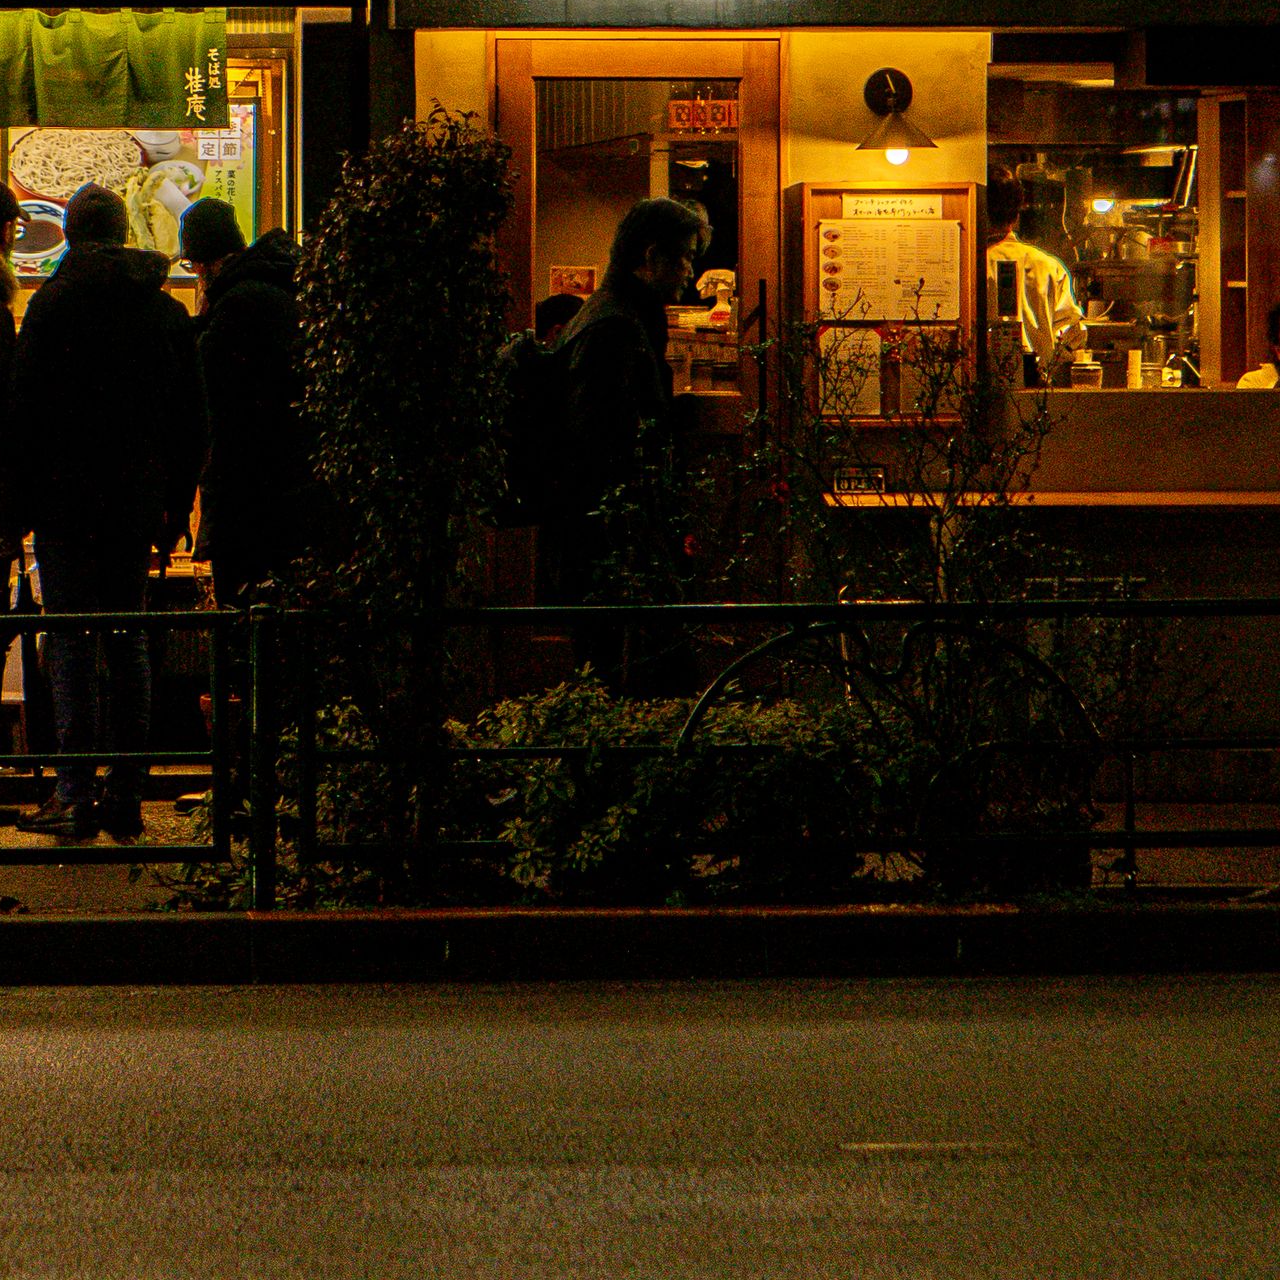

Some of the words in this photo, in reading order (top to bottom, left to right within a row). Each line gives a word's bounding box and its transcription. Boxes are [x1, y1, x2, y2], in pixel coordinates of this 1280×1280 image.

[207, 47, 221, 89] そば処
[183, 66, 207, 122] 桂庵
